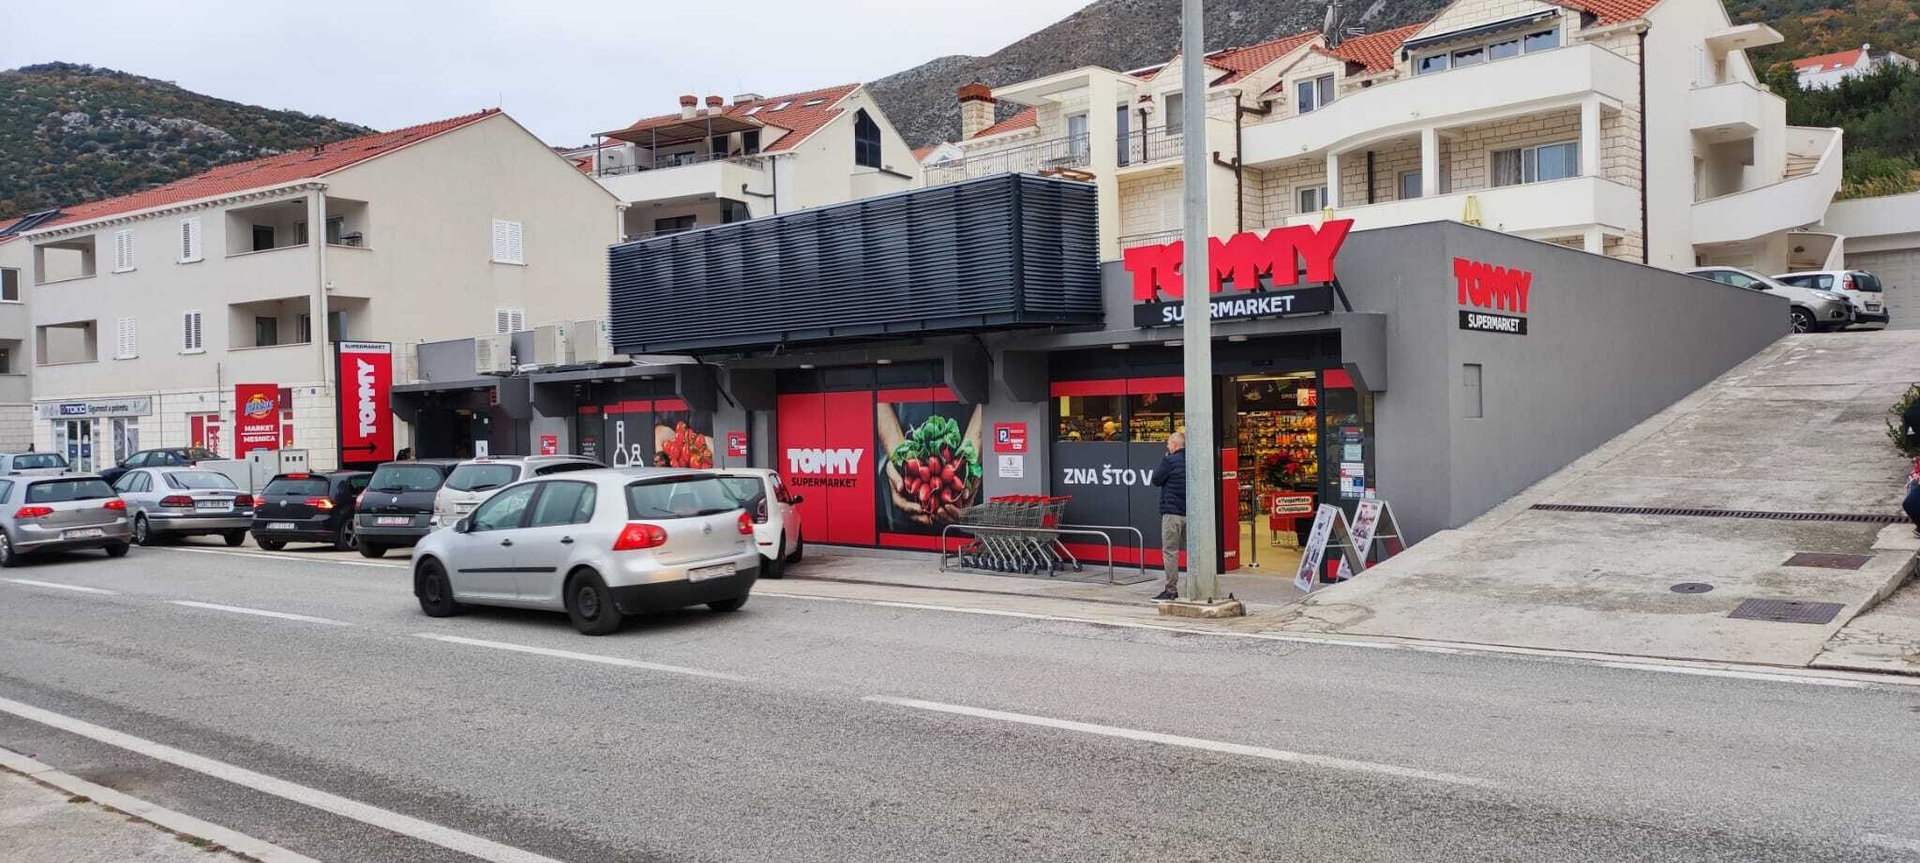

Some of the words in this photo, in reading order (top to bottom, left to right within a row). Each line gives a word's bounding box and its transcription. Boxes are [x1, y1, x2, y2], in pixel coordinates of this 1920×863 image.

[1124, 219, 1354, 300] TOMMY
[1454, 257, 1532, 314] TOMMY
[1162, 295, 1295, 322] SURMARKET
[1468, 314, 1520, 332] SUPERMARKET
[357, 358, 376, 438] TOMMY
[243, 435, 276, 443] MESNICA
[787, 448, 864, 474] TOMMY
[791, 477, 858, 488] SUPERMARKET
[1063, 468, 1099, 485] ZNA
[1102, 464, 1137, 486] ŠTO
